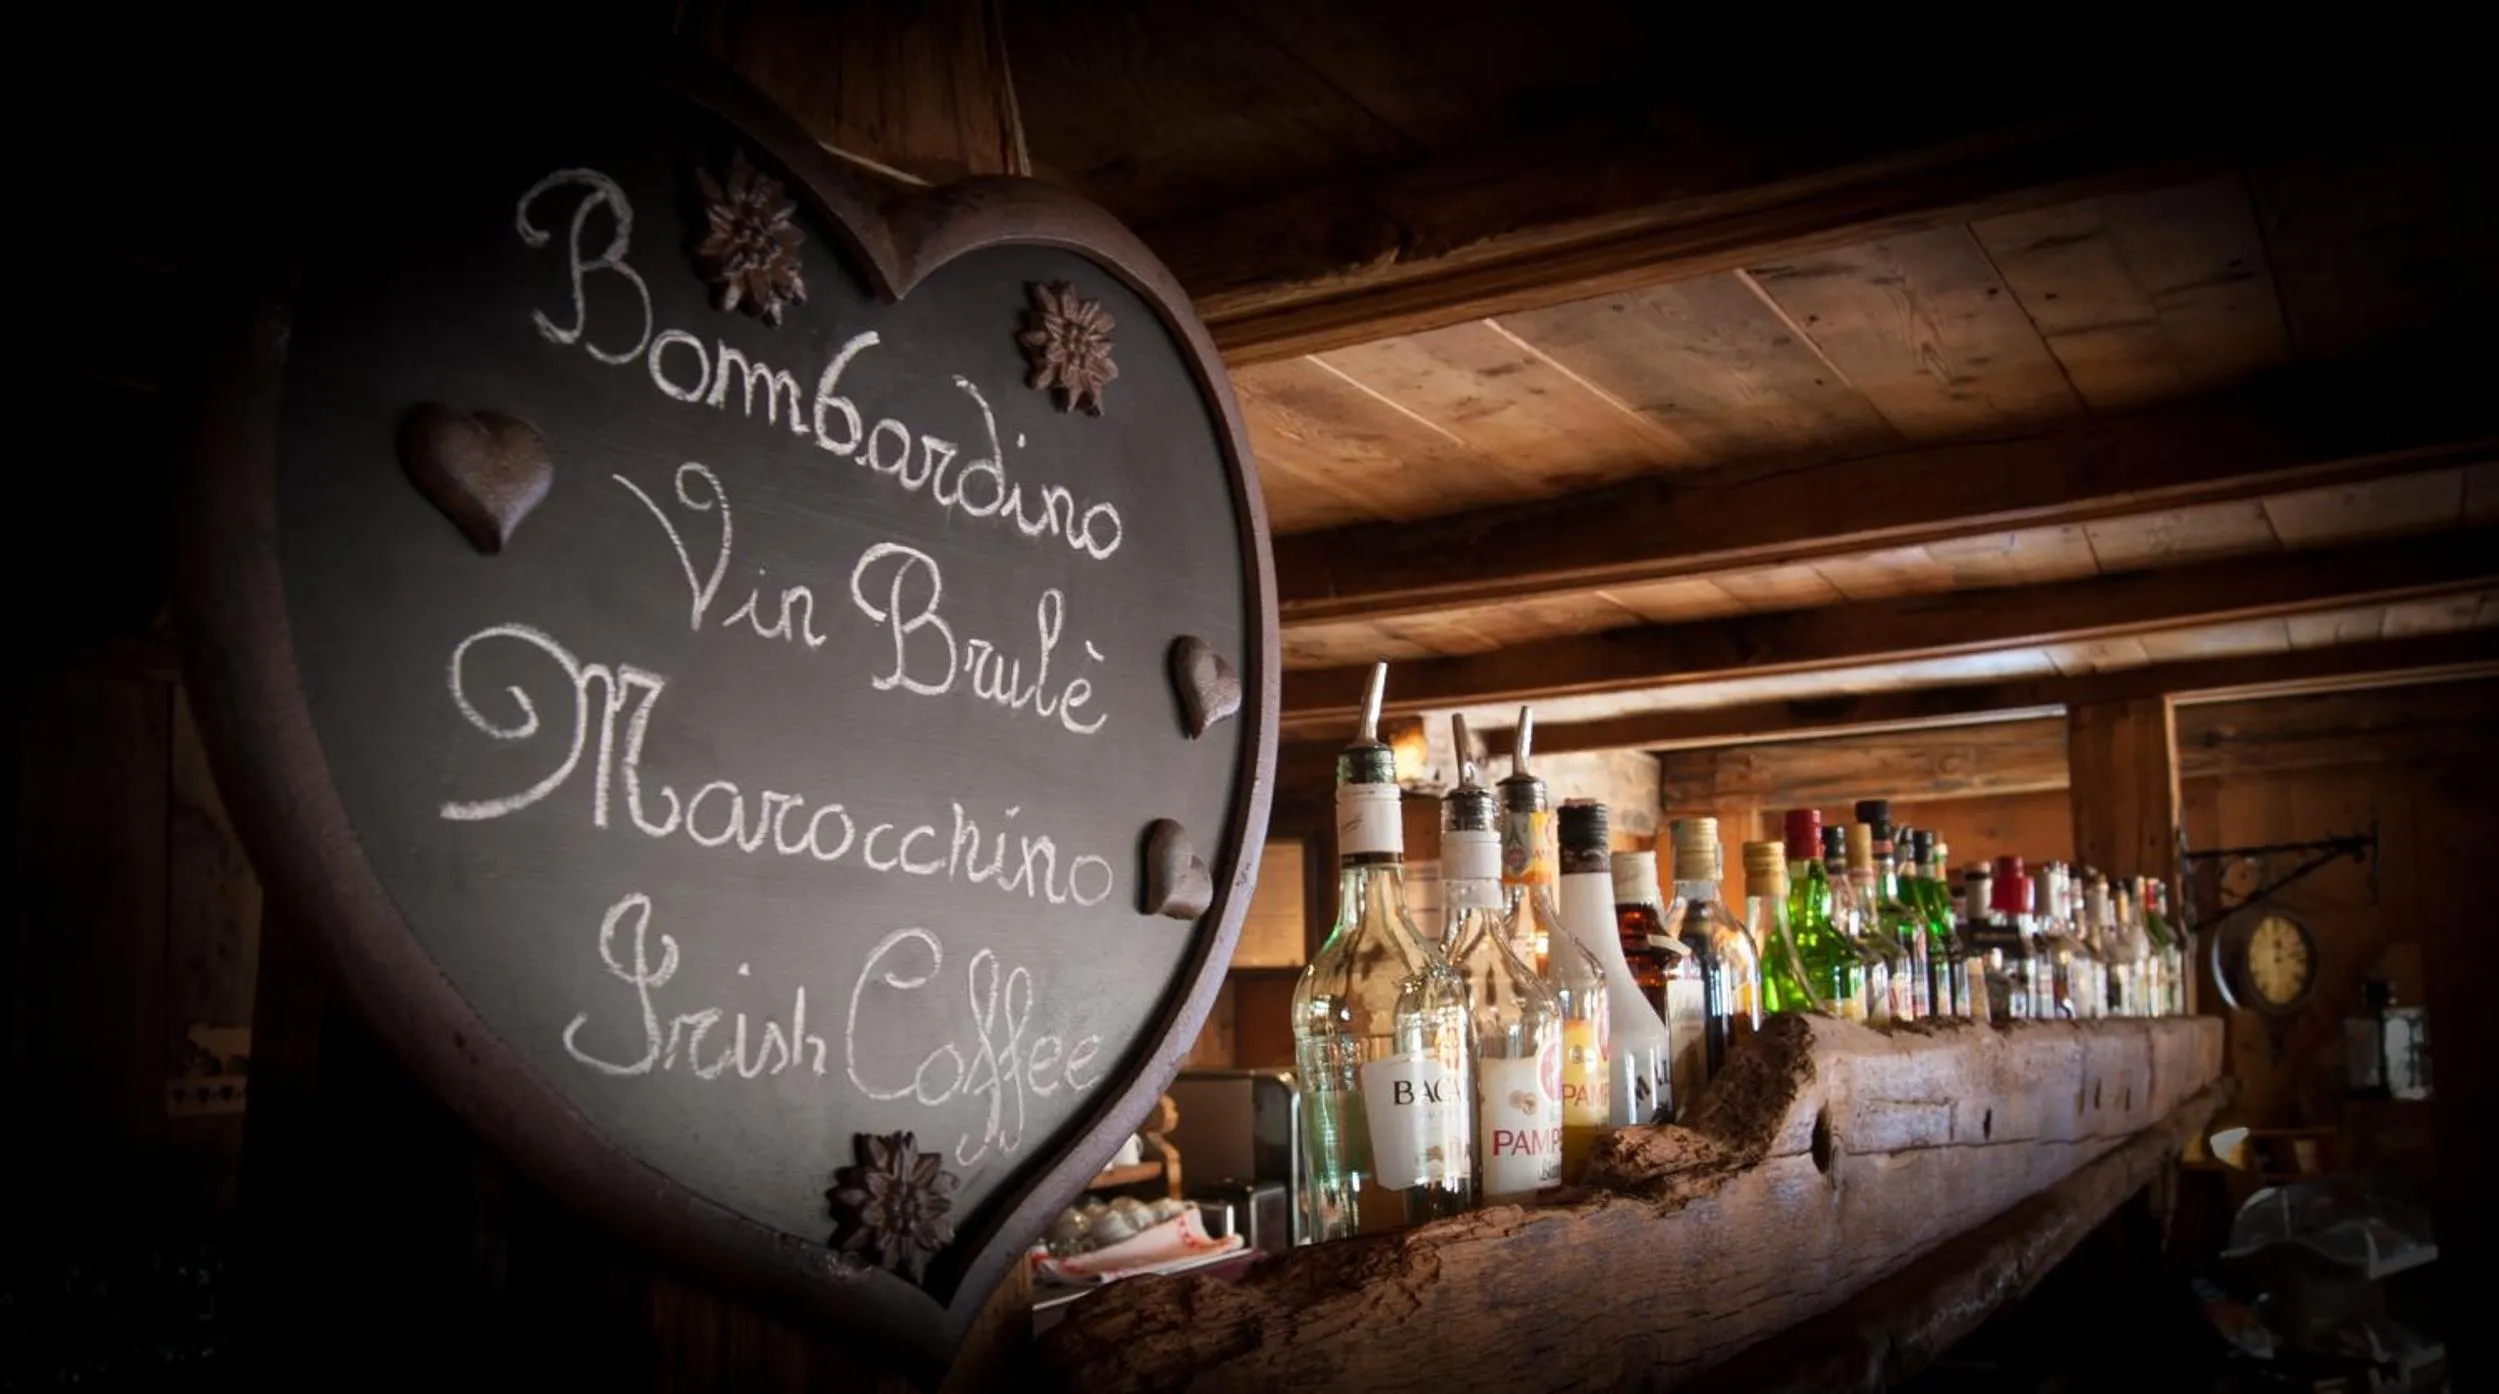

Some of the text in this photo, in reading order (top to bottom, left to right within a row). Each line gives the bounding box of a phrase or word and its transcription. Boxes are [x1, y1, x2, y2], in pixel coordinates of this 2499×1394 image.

[516, 168, 1123, 560] Bombardino
[613, 462, 1106, 735] Vin Brulè
[440, 623, 1114, 906] Marocchino
[563, 893, 1105, 1167] Irish Coffee
